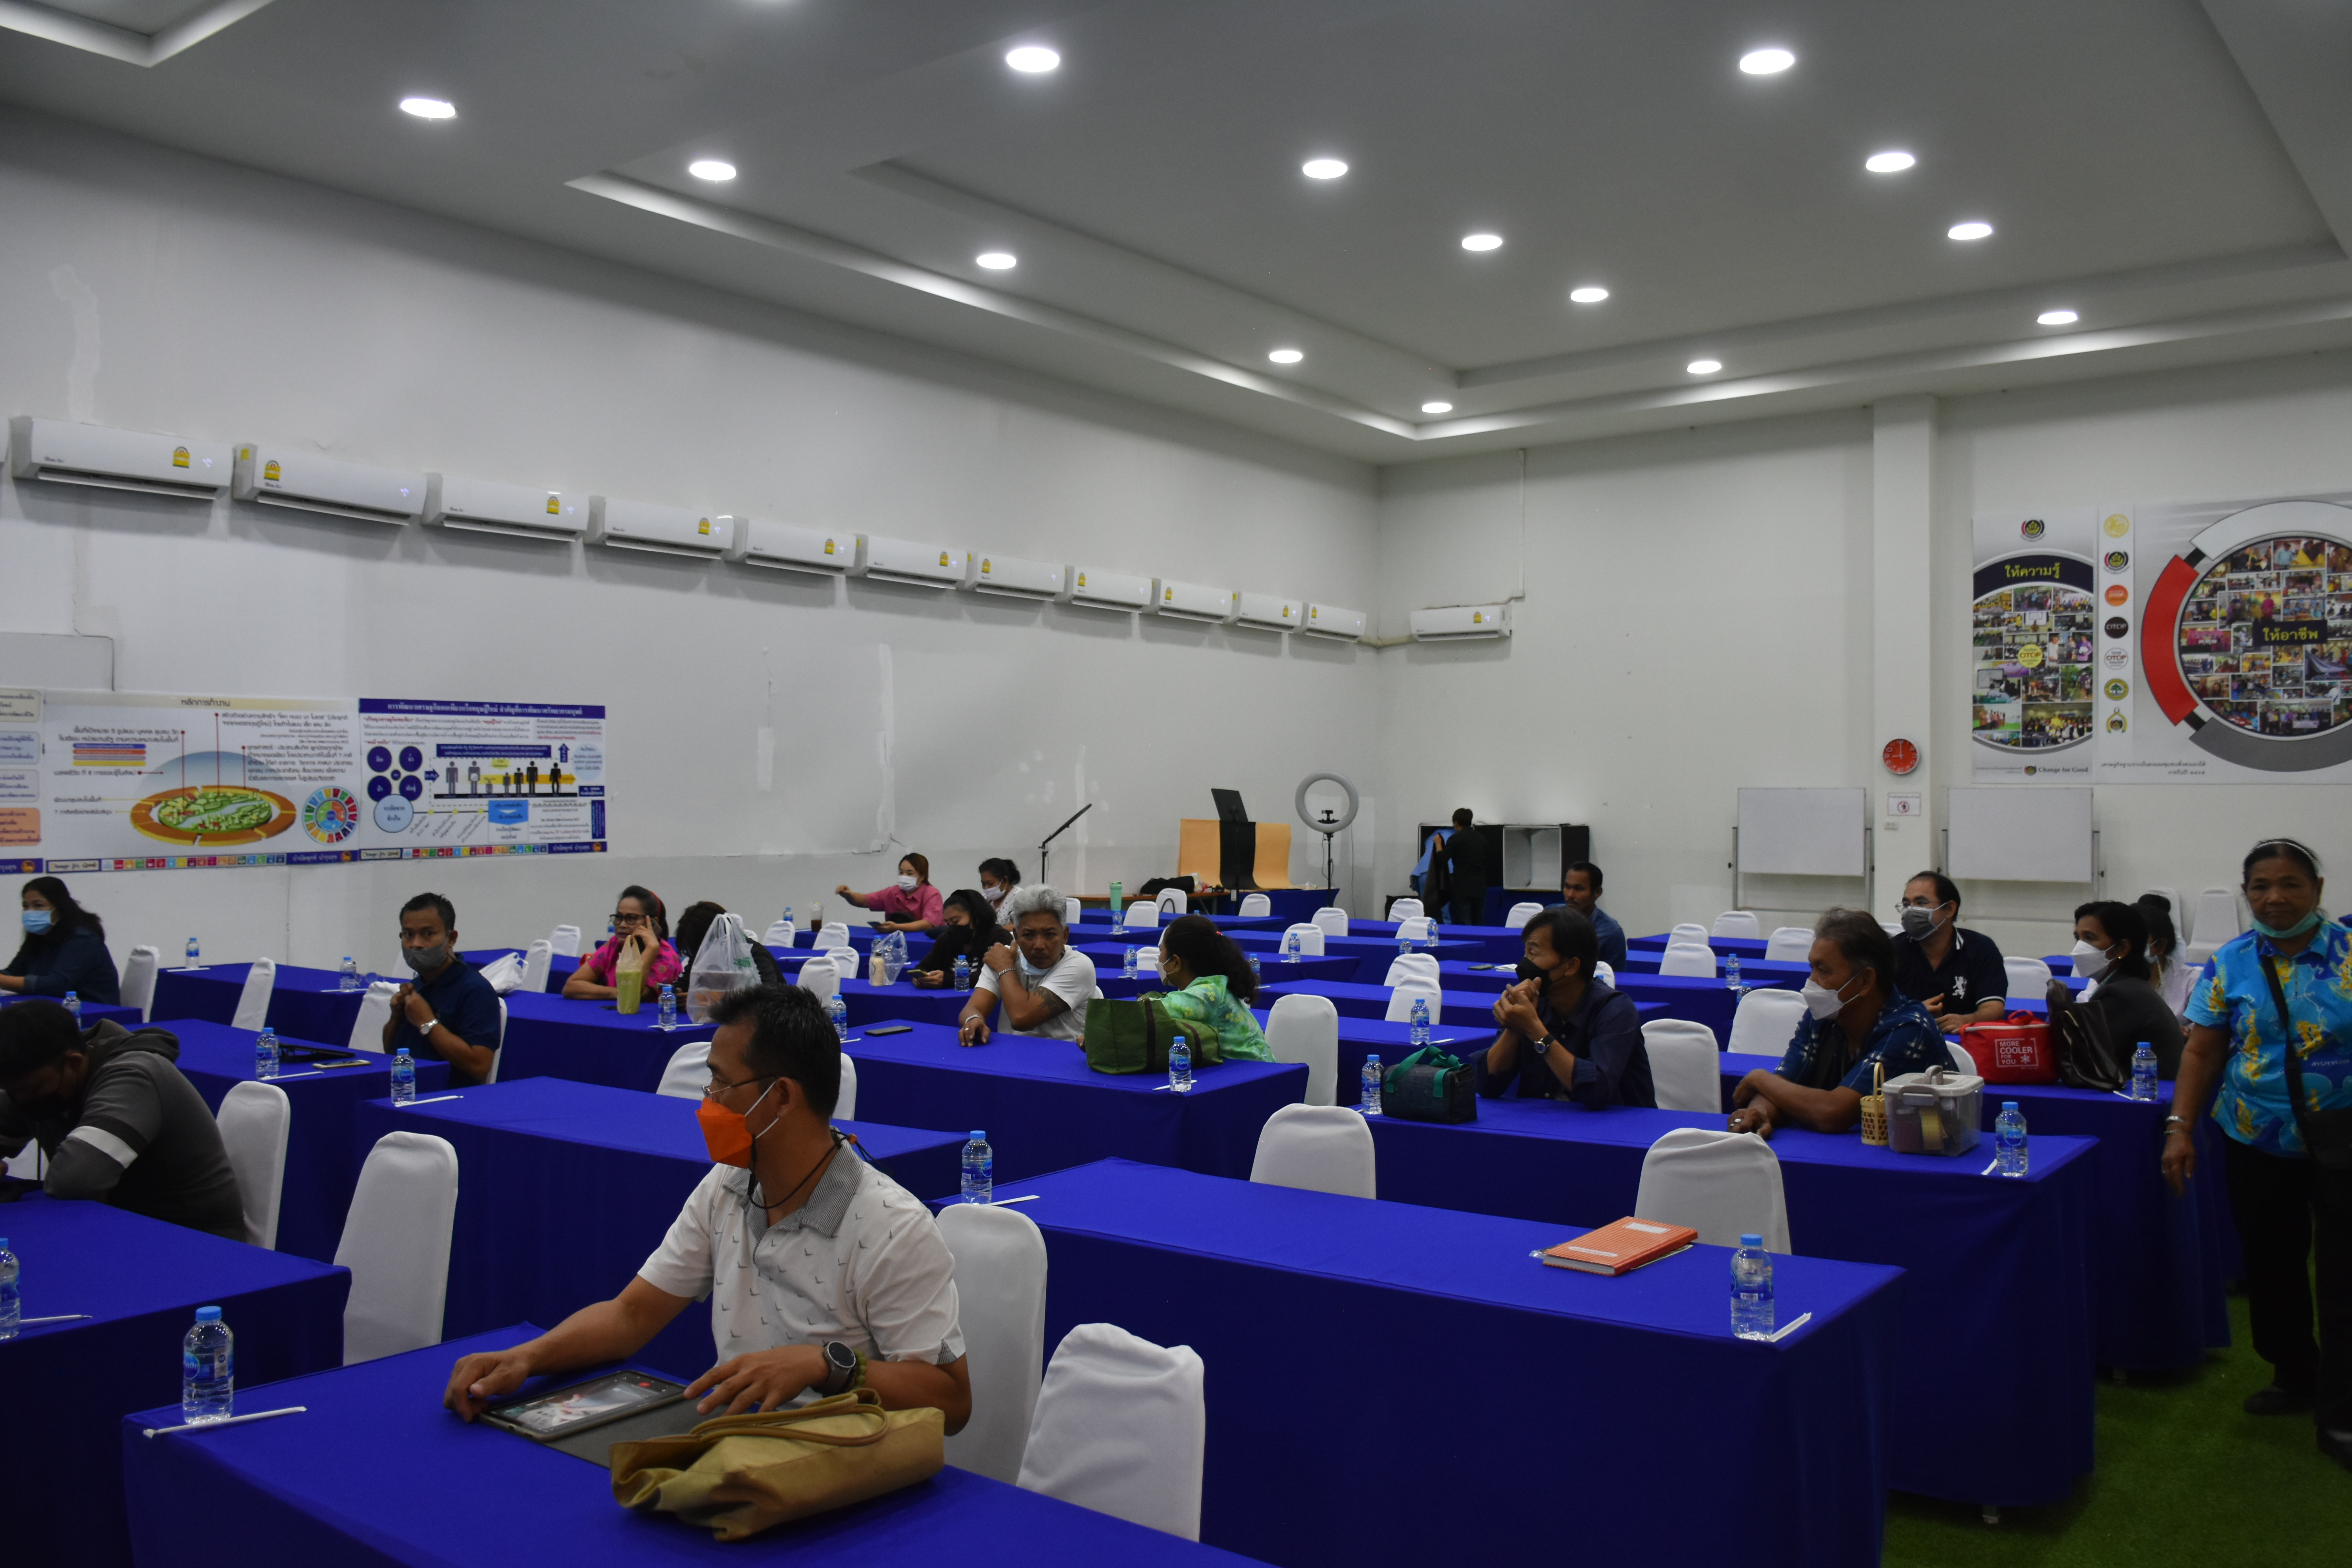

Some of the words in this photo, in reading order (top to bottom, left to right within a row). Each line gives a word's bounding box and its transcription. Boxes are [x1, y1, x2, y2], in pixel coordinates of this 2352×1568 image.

[2005, 562, 2060, 579] ให้ความรู้
[2262, 626, 2319, 642] ให้อาชีพ
[181, 698, 230, 707] หลักการทำงาน
